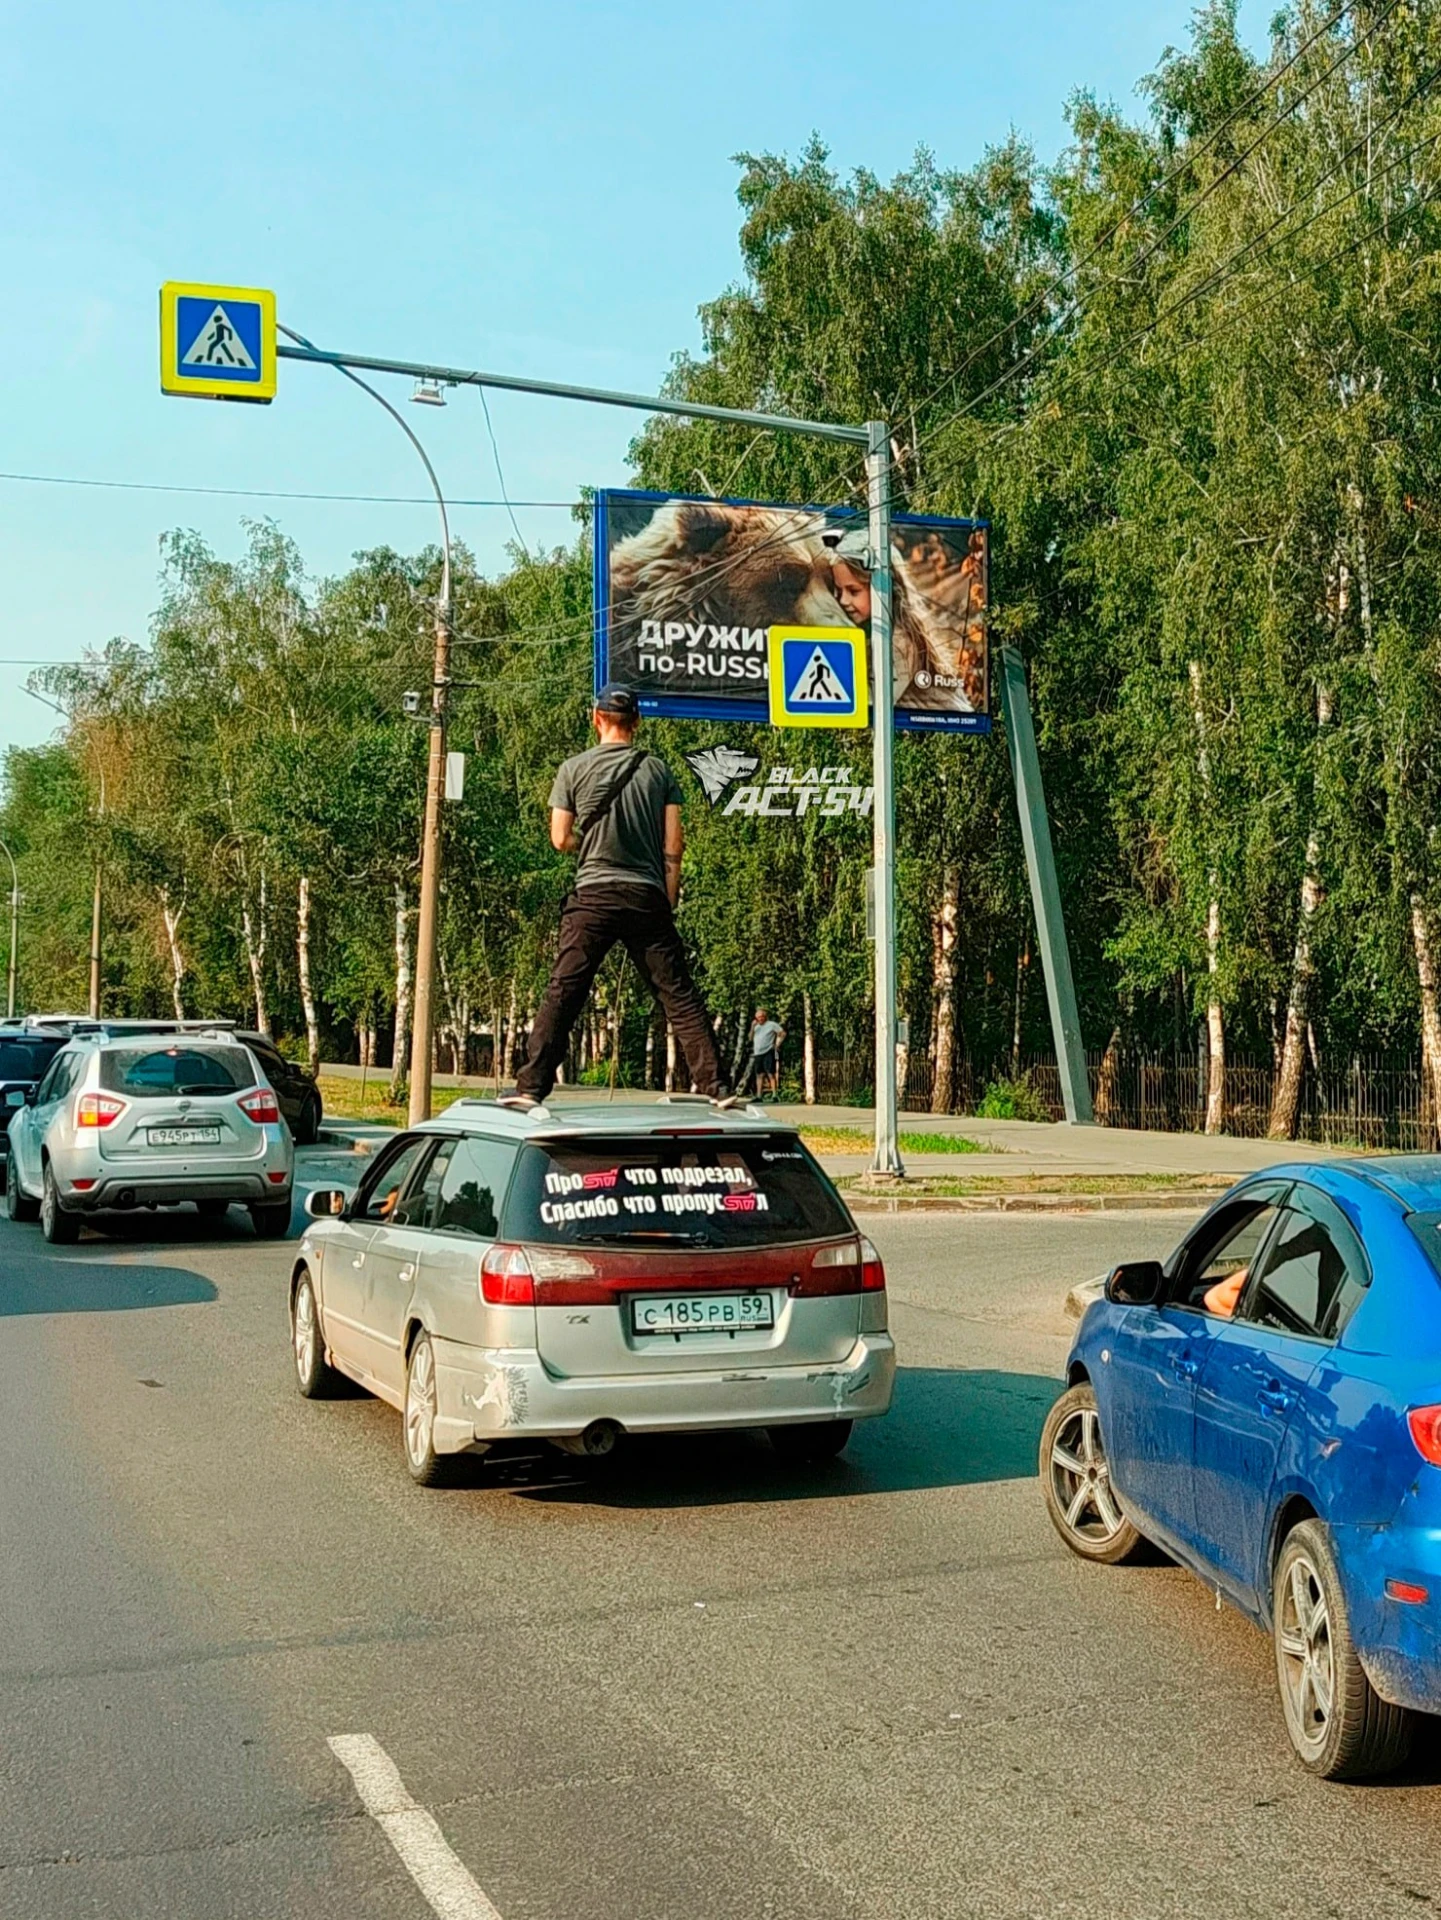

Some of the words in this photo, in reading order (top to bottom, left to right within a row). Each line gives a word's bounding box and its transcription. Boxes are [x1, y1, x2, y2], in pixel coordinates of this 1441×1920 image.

[638, 619, 769, 652] ДРУЖИ
[934, 674, 965, 688] Russ
[624, 1168, 658, 1185] что
[661, 1166, 752, 1186] подрезал,
[540, 1194, 619, 1224] Спасибо
[623, 1196, 657, 1214] что
[742, 1297, 763, 1315] 59
